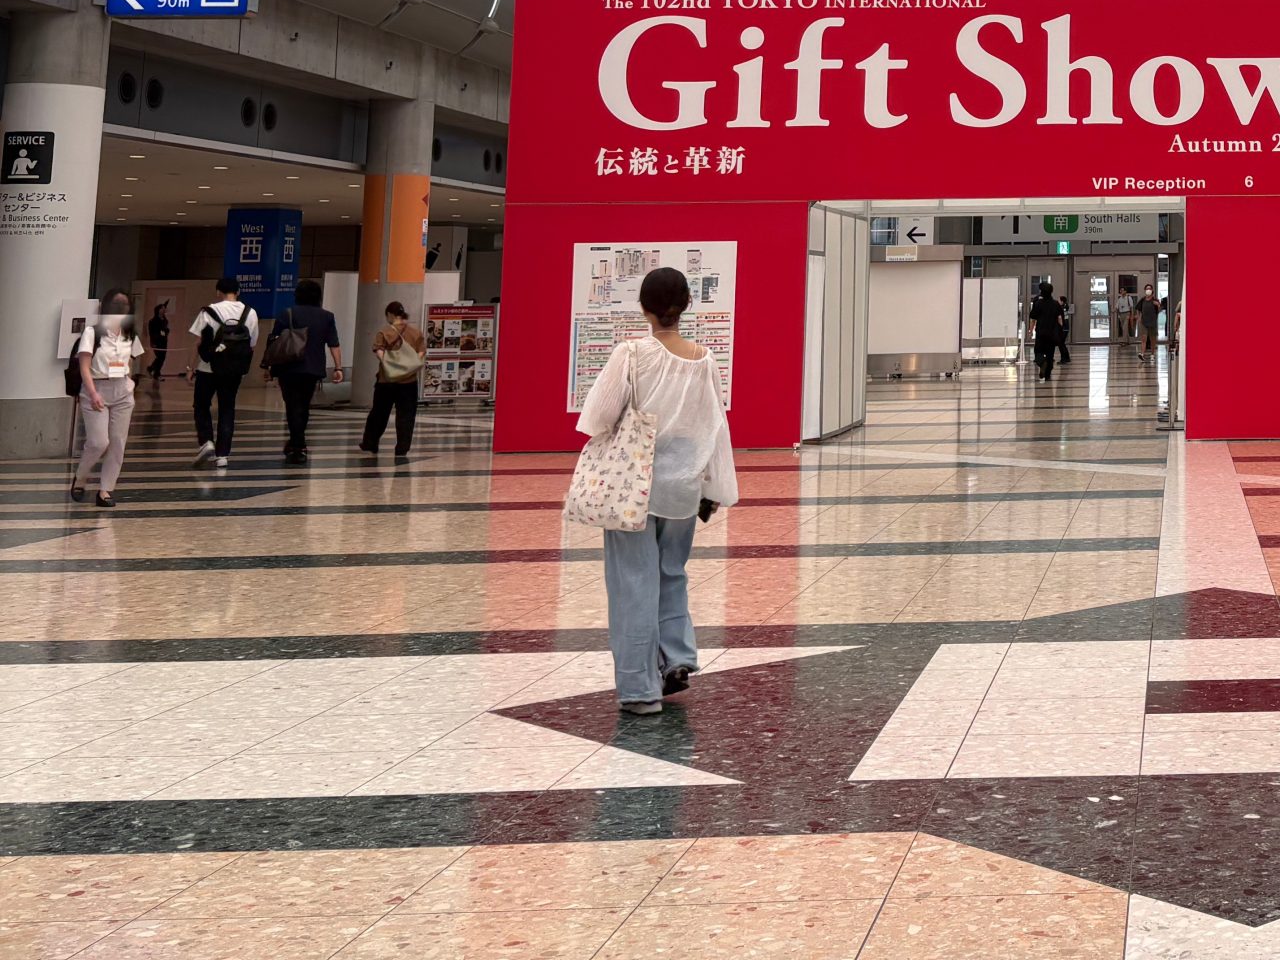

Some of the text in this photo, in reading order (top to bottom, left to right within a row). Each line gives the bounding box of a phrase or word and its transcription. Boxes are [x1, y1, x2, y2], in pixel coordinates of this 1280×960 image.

[598, 14, 908, 131] Gift
[8, 135, 46, 145] SERVICE
[1168, 133, 1262, 153] Autumn
[595, 146, 746, 176] 伝統と革新
[1092, 176, 1206, 191] VIP Reception
[1244, 176, 1254, 188] 6
[0, 192, 67, 202] ター&ビジネス
[4, 203, 41, 213] センター
[8, 214, 41, 222] Business
[43, 214, 69, 222] Center
[1084, 213, 1141, 224] South Halls
[241, 224, 264, 233] West
[1084, 226, 1103, 234] 390m
[239, 237, 263, 263] 西
